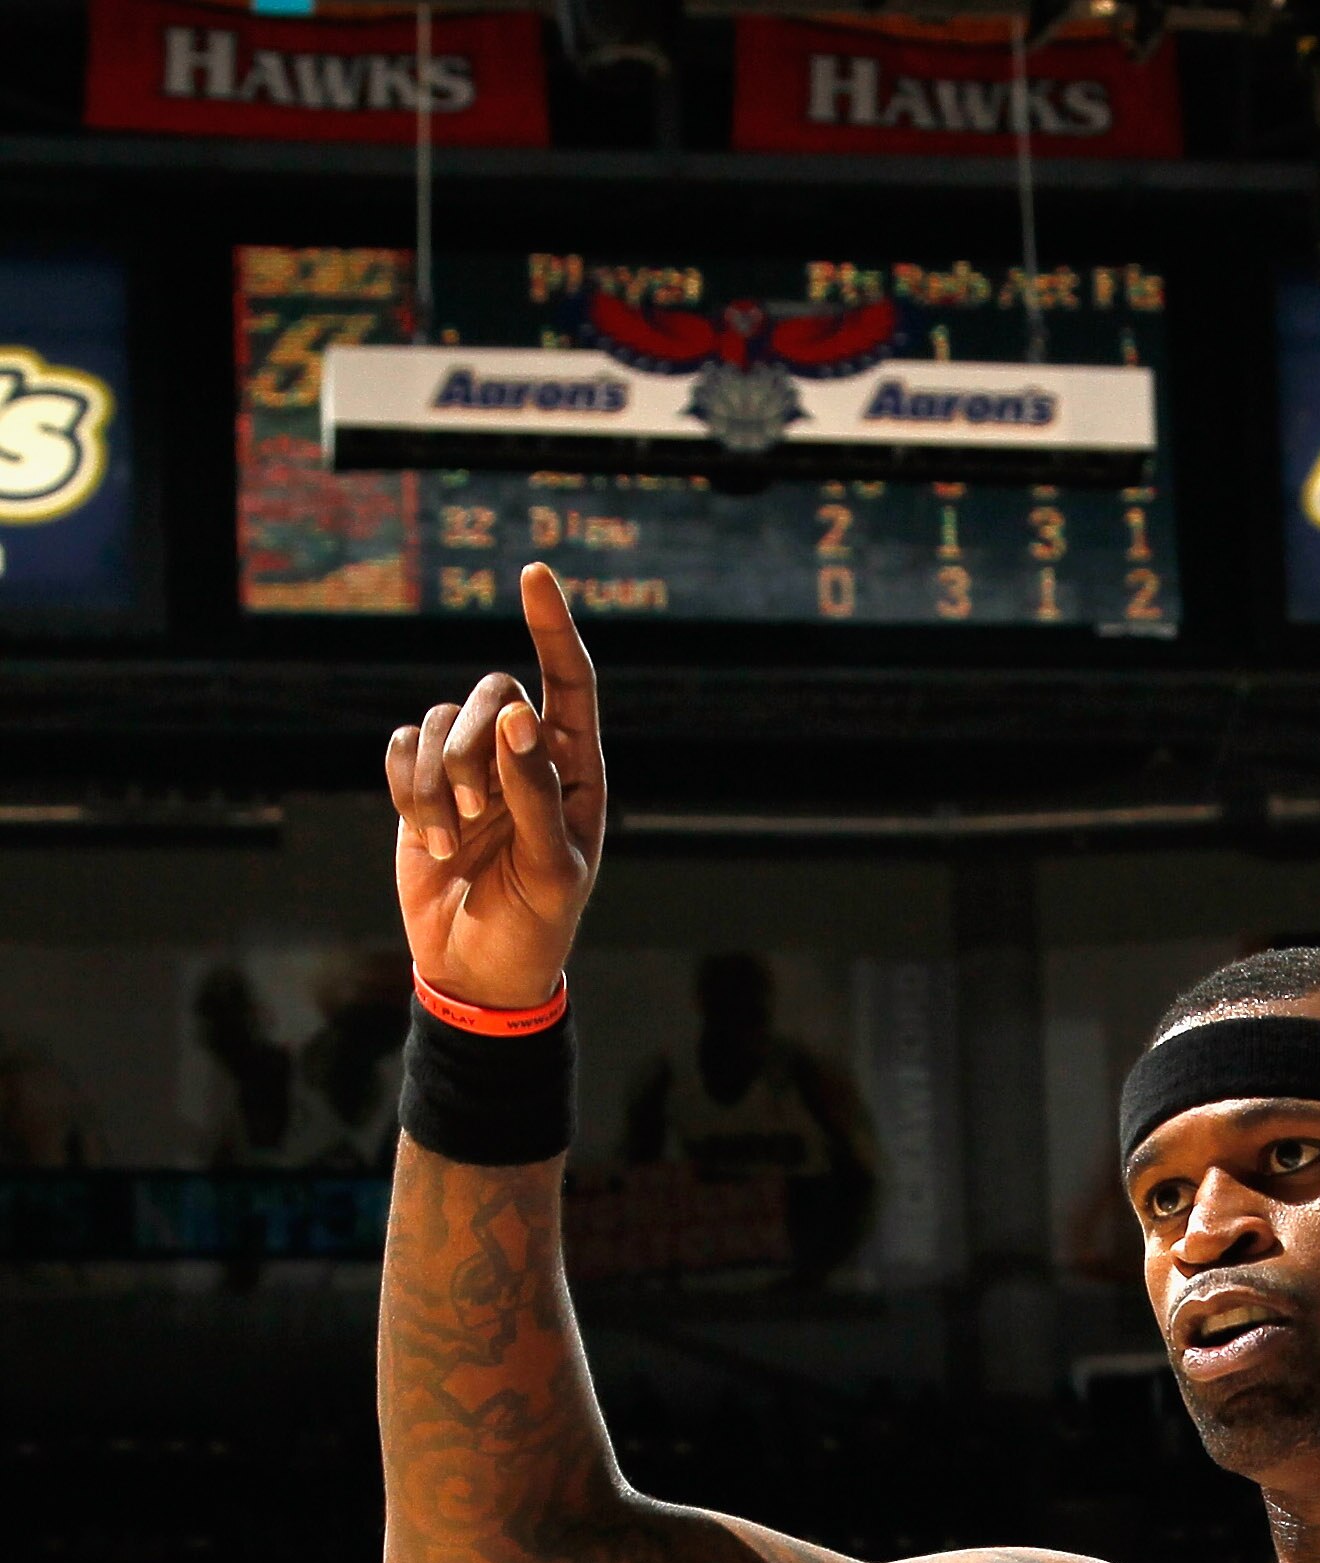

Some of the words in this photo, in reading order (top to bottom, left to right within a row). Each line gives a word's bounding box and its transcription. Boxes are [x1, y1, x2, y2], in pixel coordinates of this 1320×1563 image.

[162, 26, 478, 115] HAWKS
[807, 53, 1114, 138] HAWKS
[429, 367, 629, 413] Aaron's
[864, 382, 1059, 426] Aaron's
[816, 504, 854, 559] 2
[936, 506, 964, 560] 1
[1029, 506, 1067, 561] 3
[1124, 506, 1152, 561] 1
[935, 565, 973, 620] 3
[1037, 566, 1063, 621] 1
[1125, 568, 1164, 620] 2
[442, 1007, 475, 1026] PLAY
